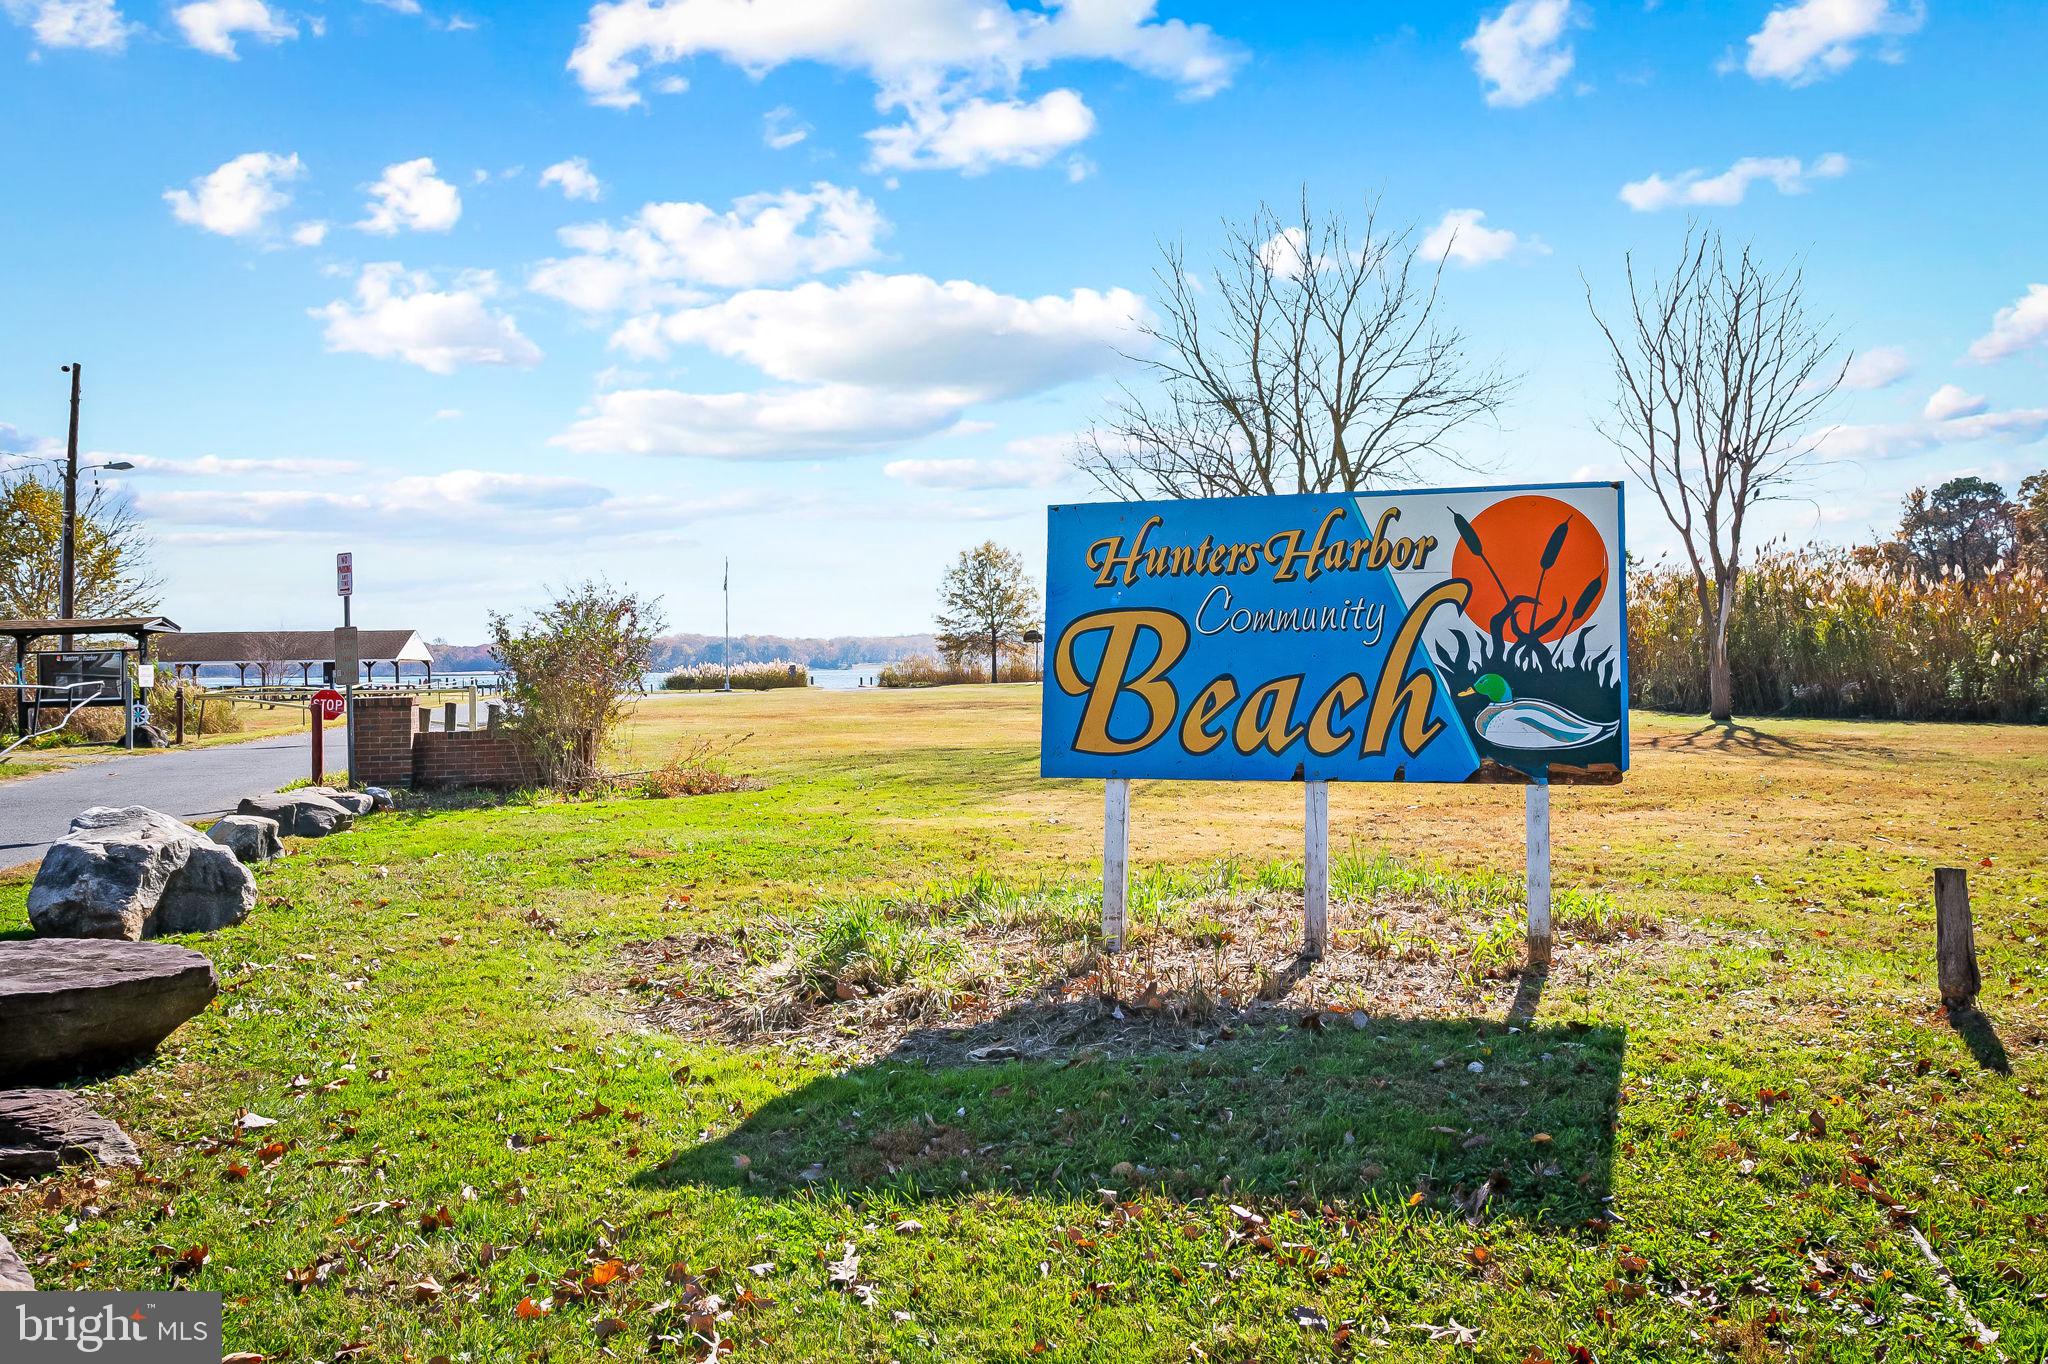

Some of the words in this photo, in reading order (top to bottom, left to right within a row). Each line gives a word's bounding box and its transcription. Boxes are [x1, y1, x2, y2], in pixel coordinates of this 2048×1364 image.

[1085, 514, 1263, 588] Hunters
[1264, 507, 1438, 583] Harbor
[1195, 585, 1386, 646] Community
[1053, 578, 1473, 760] Beach
